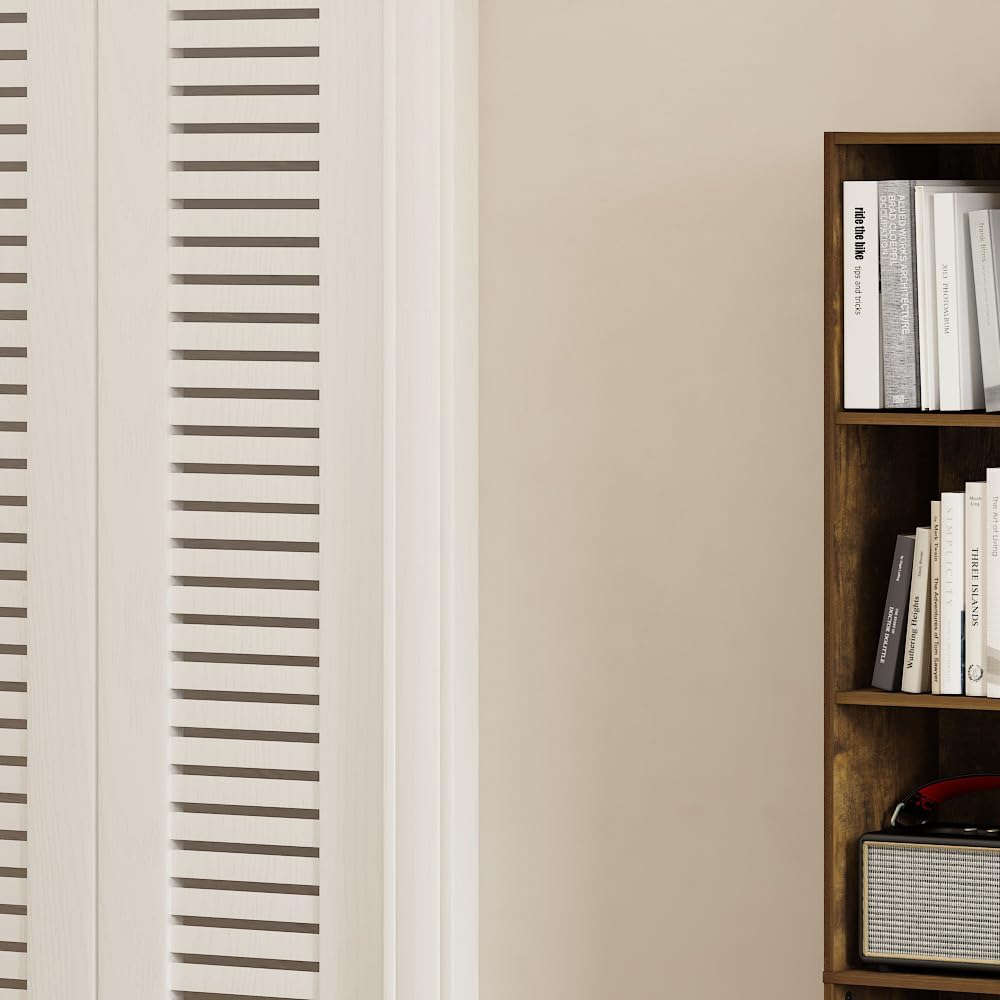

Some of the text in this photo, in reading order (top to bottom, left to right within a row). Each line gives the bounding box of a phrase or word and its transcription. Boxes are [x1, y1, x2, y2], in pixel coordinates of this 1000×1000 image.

[855, 207, 866, 260] ride the bike
[880, 195, 888, 255] OCCUPATION
[888, 195, 898, 266] BRAD CLOEPFIL
[854, 266, 863, 315] tips and tricks
[897, 194, 910, 335] ALLIED WORKS ARCHITECTURE
[942, 283, 950, 335] PHOTOALBUM
[944, 506, 953, 607] SIMPLICITY
[880, 606, 894, 663] DOCTOR DOLITTLE
[907, 596, 920, 669] Wuthering Heights
